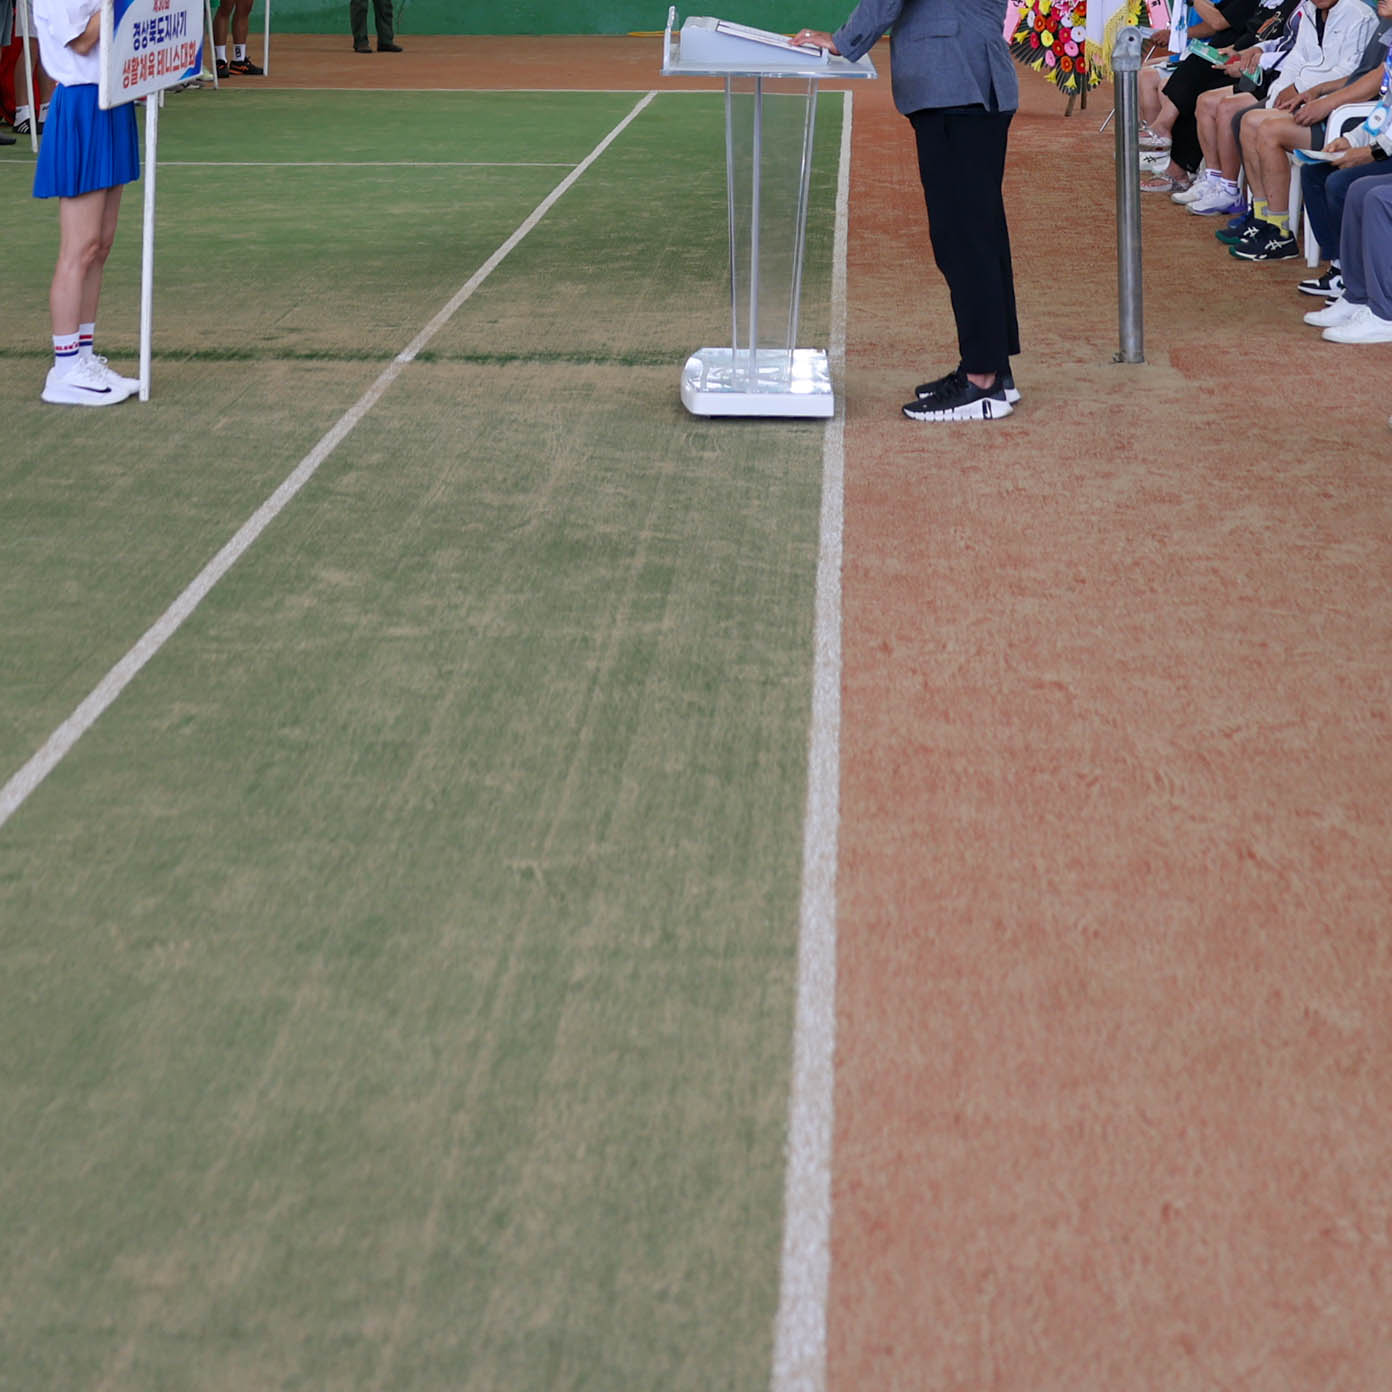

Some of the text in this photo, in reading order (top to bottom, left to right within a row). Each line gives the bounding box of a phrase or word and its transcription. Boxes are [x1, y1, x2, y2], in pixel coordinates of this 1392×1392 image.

[133, 10, 187, 52] 경상북도지사기
[122, 40, 197, 90] 생활체육 테니스대회
